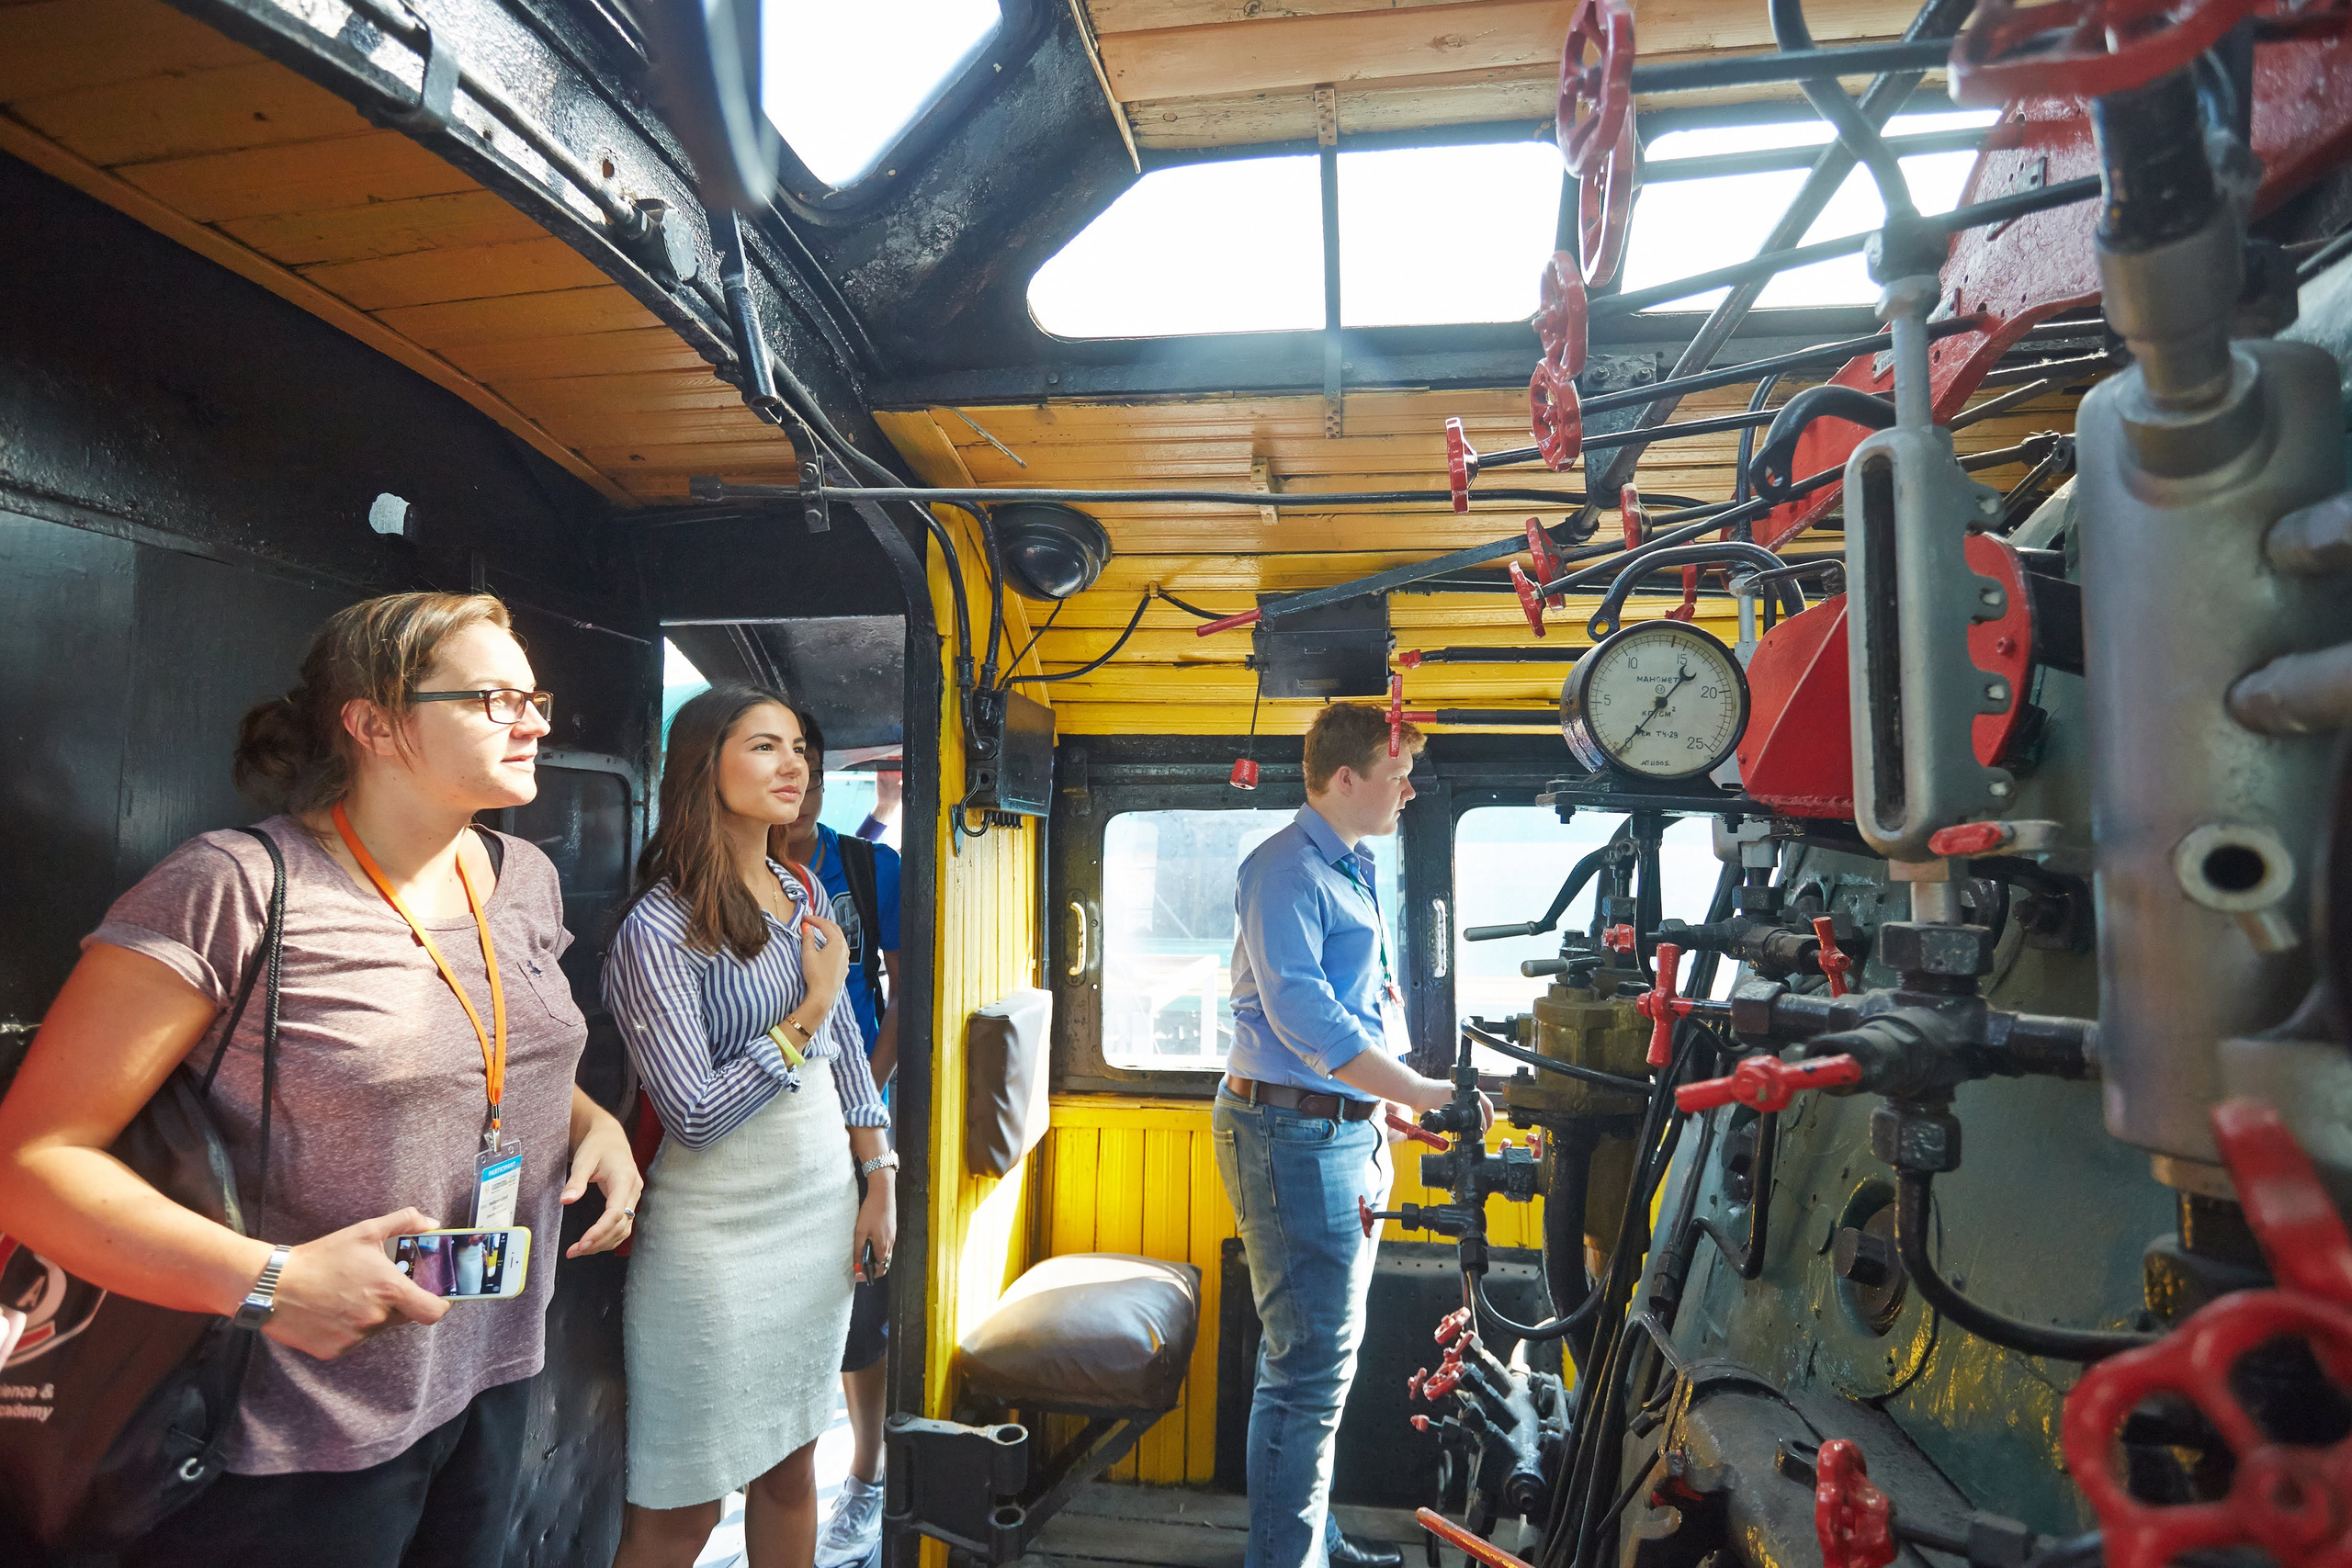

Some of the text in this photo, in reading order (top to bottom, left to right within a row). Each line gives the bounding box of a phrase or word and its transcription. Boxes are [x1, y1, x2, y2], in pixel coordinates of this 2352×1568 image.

[1627, 657, 1638, 669] 10
[1676, 653, 1688, 666] 15
[1701, 685, 1718, 699] 20
[1603, 694, 1611, 706] 5
[1624, 737, 1633, 750] 0
[1686, 736, 1704, 750] 25
[488, 1161, 516, 1177] PARTICIPANT
[0, 1382, 55, 1399] ience &
[0, 1403, 54, 1423] cademy
